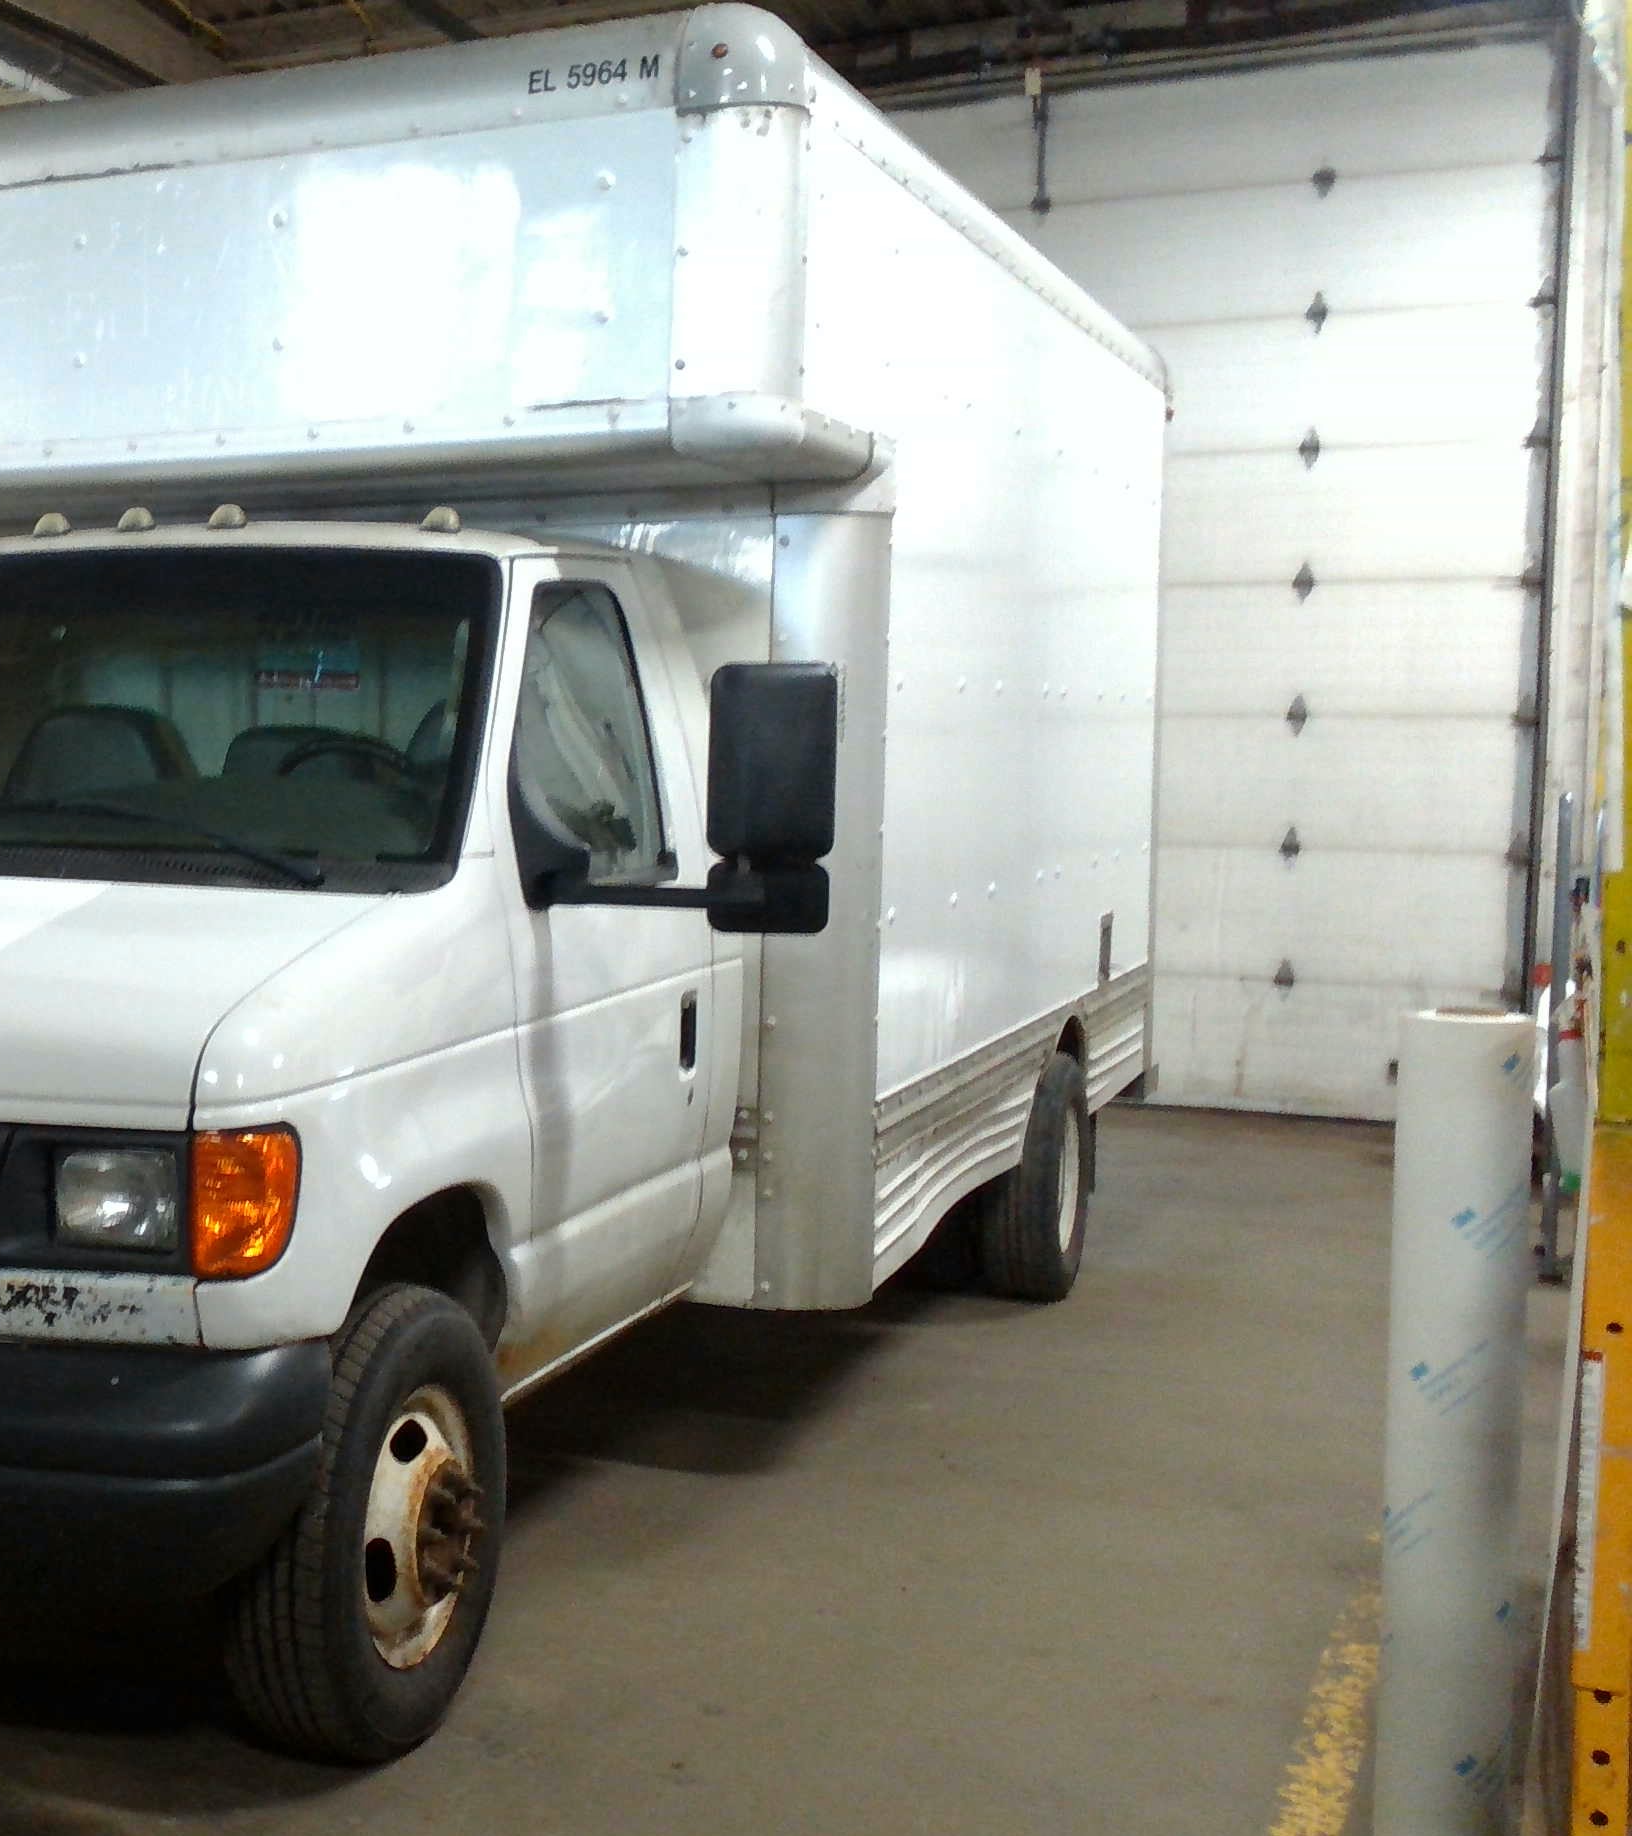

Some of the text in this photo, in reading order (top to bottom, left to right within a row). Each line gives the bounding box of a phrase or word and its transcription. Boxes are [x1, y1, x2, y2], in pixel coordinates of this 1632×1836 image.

[528, 54, 660, 94] EL 5964 M
